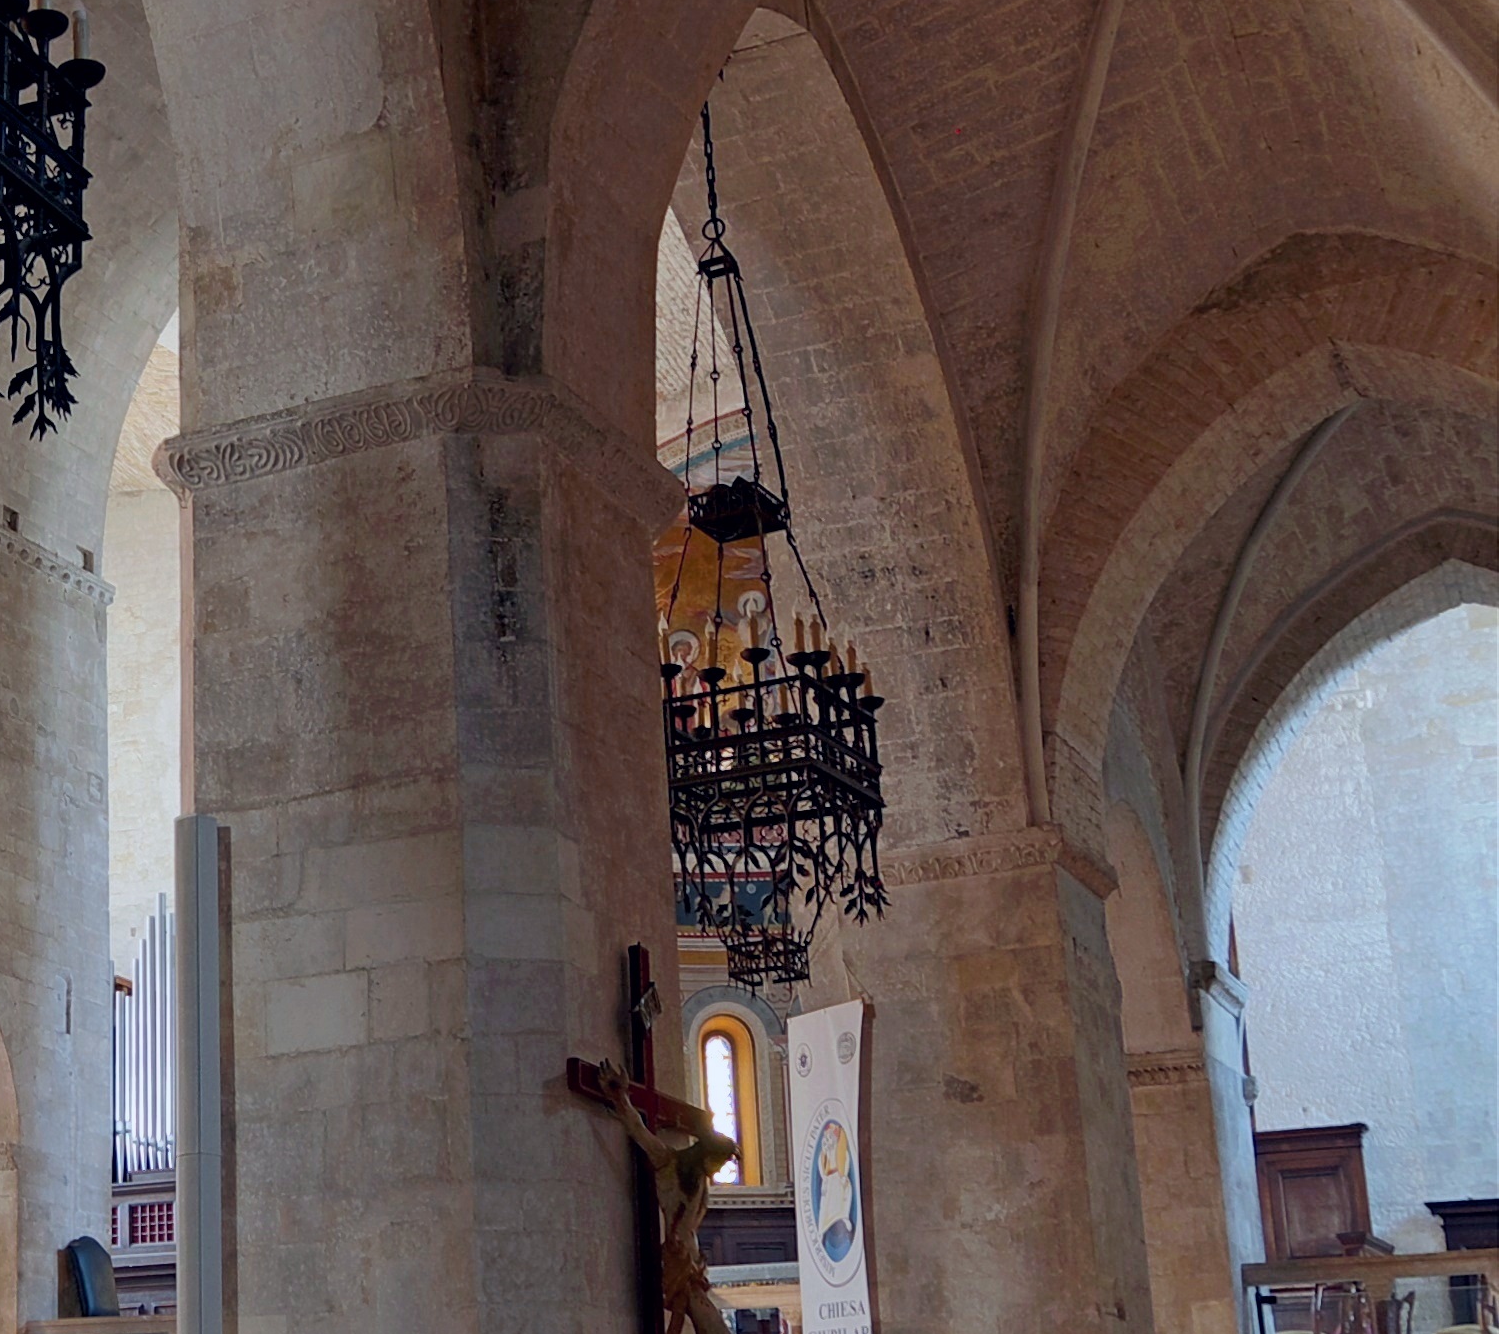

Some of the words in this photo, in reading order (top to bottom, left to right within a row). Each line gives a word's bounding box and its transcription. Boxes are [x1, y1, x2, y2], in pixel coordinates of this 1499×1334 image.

[808, 1104, 831, 1140] PATER
[802, 1141, 815, 1184] SICUT
[818, 1299, 866, 1321] CHIESA
